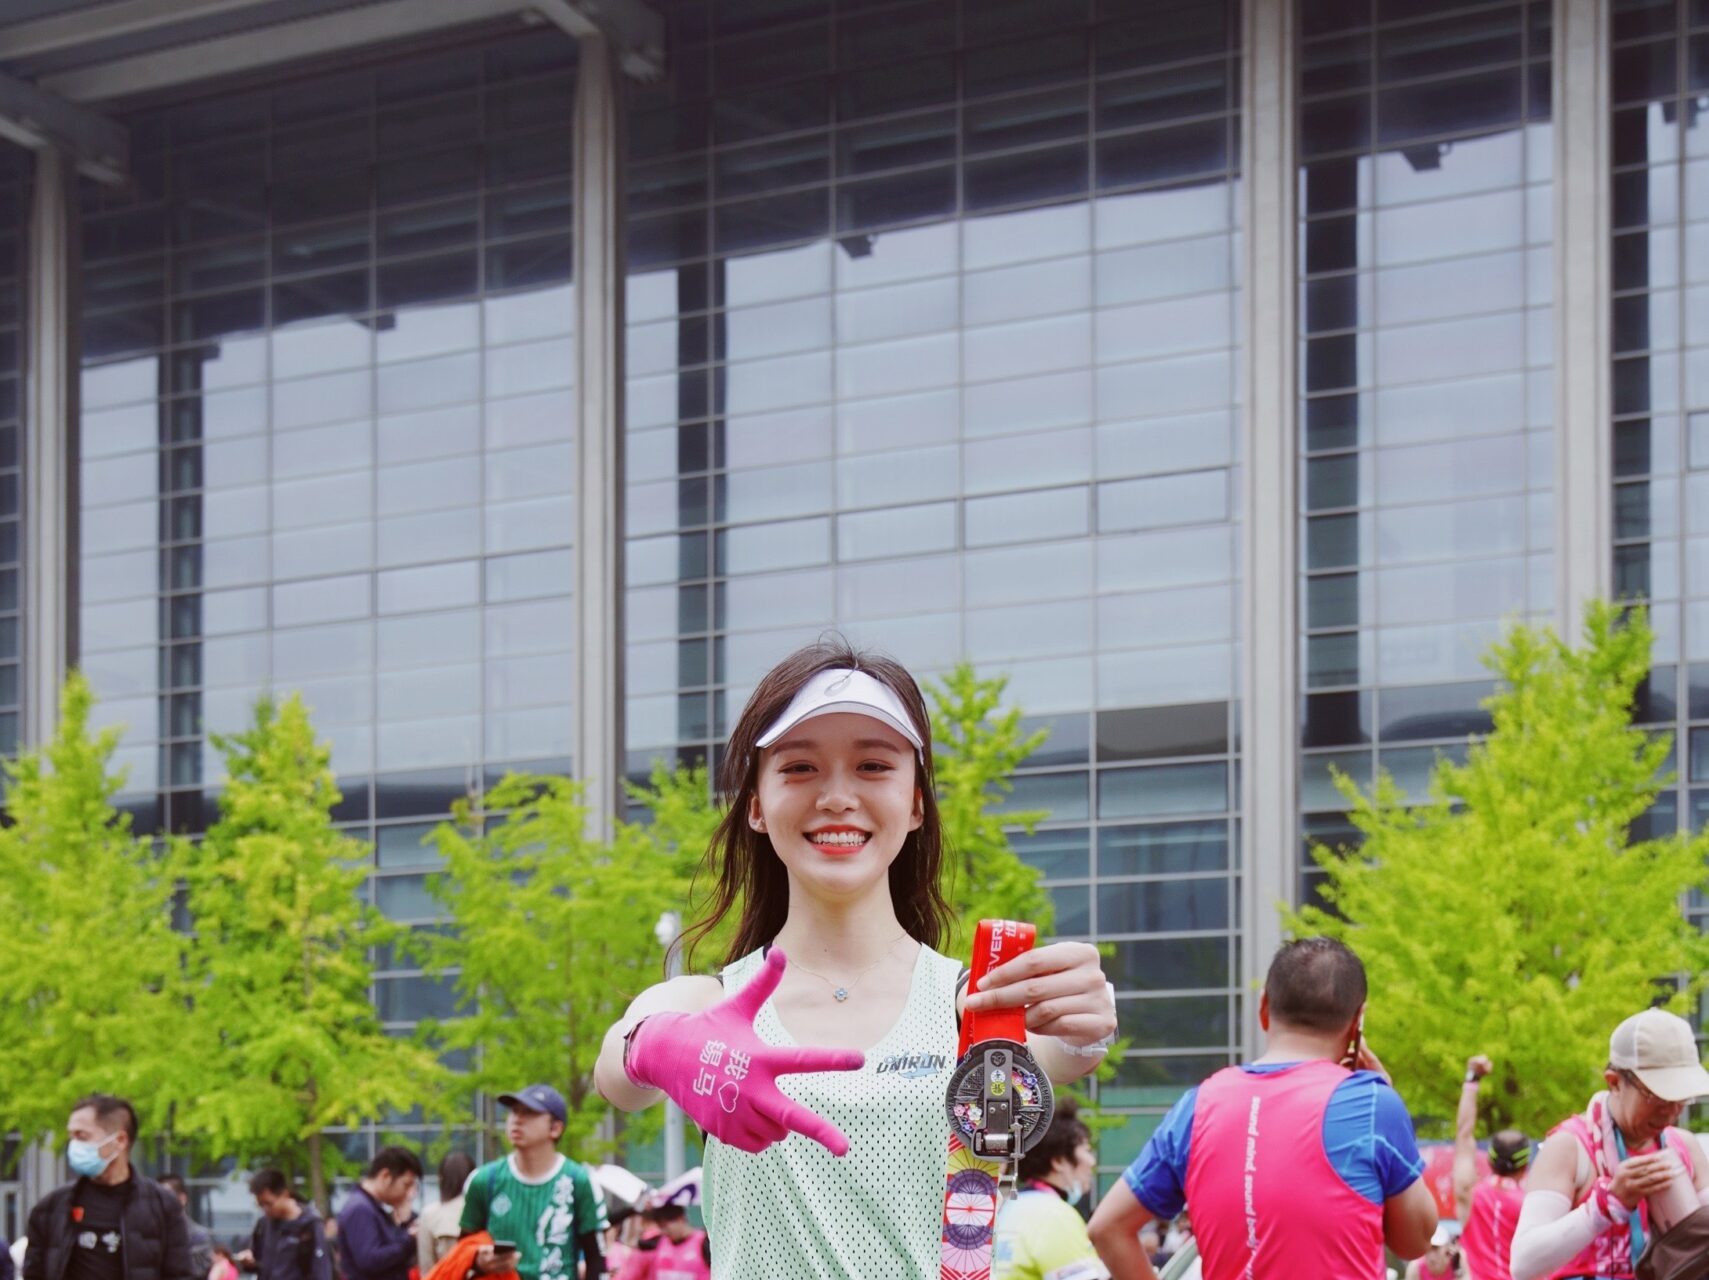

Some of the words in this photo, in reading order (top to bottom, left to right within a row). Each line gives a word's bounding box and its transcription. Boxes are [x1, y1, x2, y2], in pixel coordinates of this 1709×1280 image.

[724, 1048, 751, 1081] 我
[1247, 1096, 1261, 1136] sound
[1244, 1175, 1256, 1216] sound
